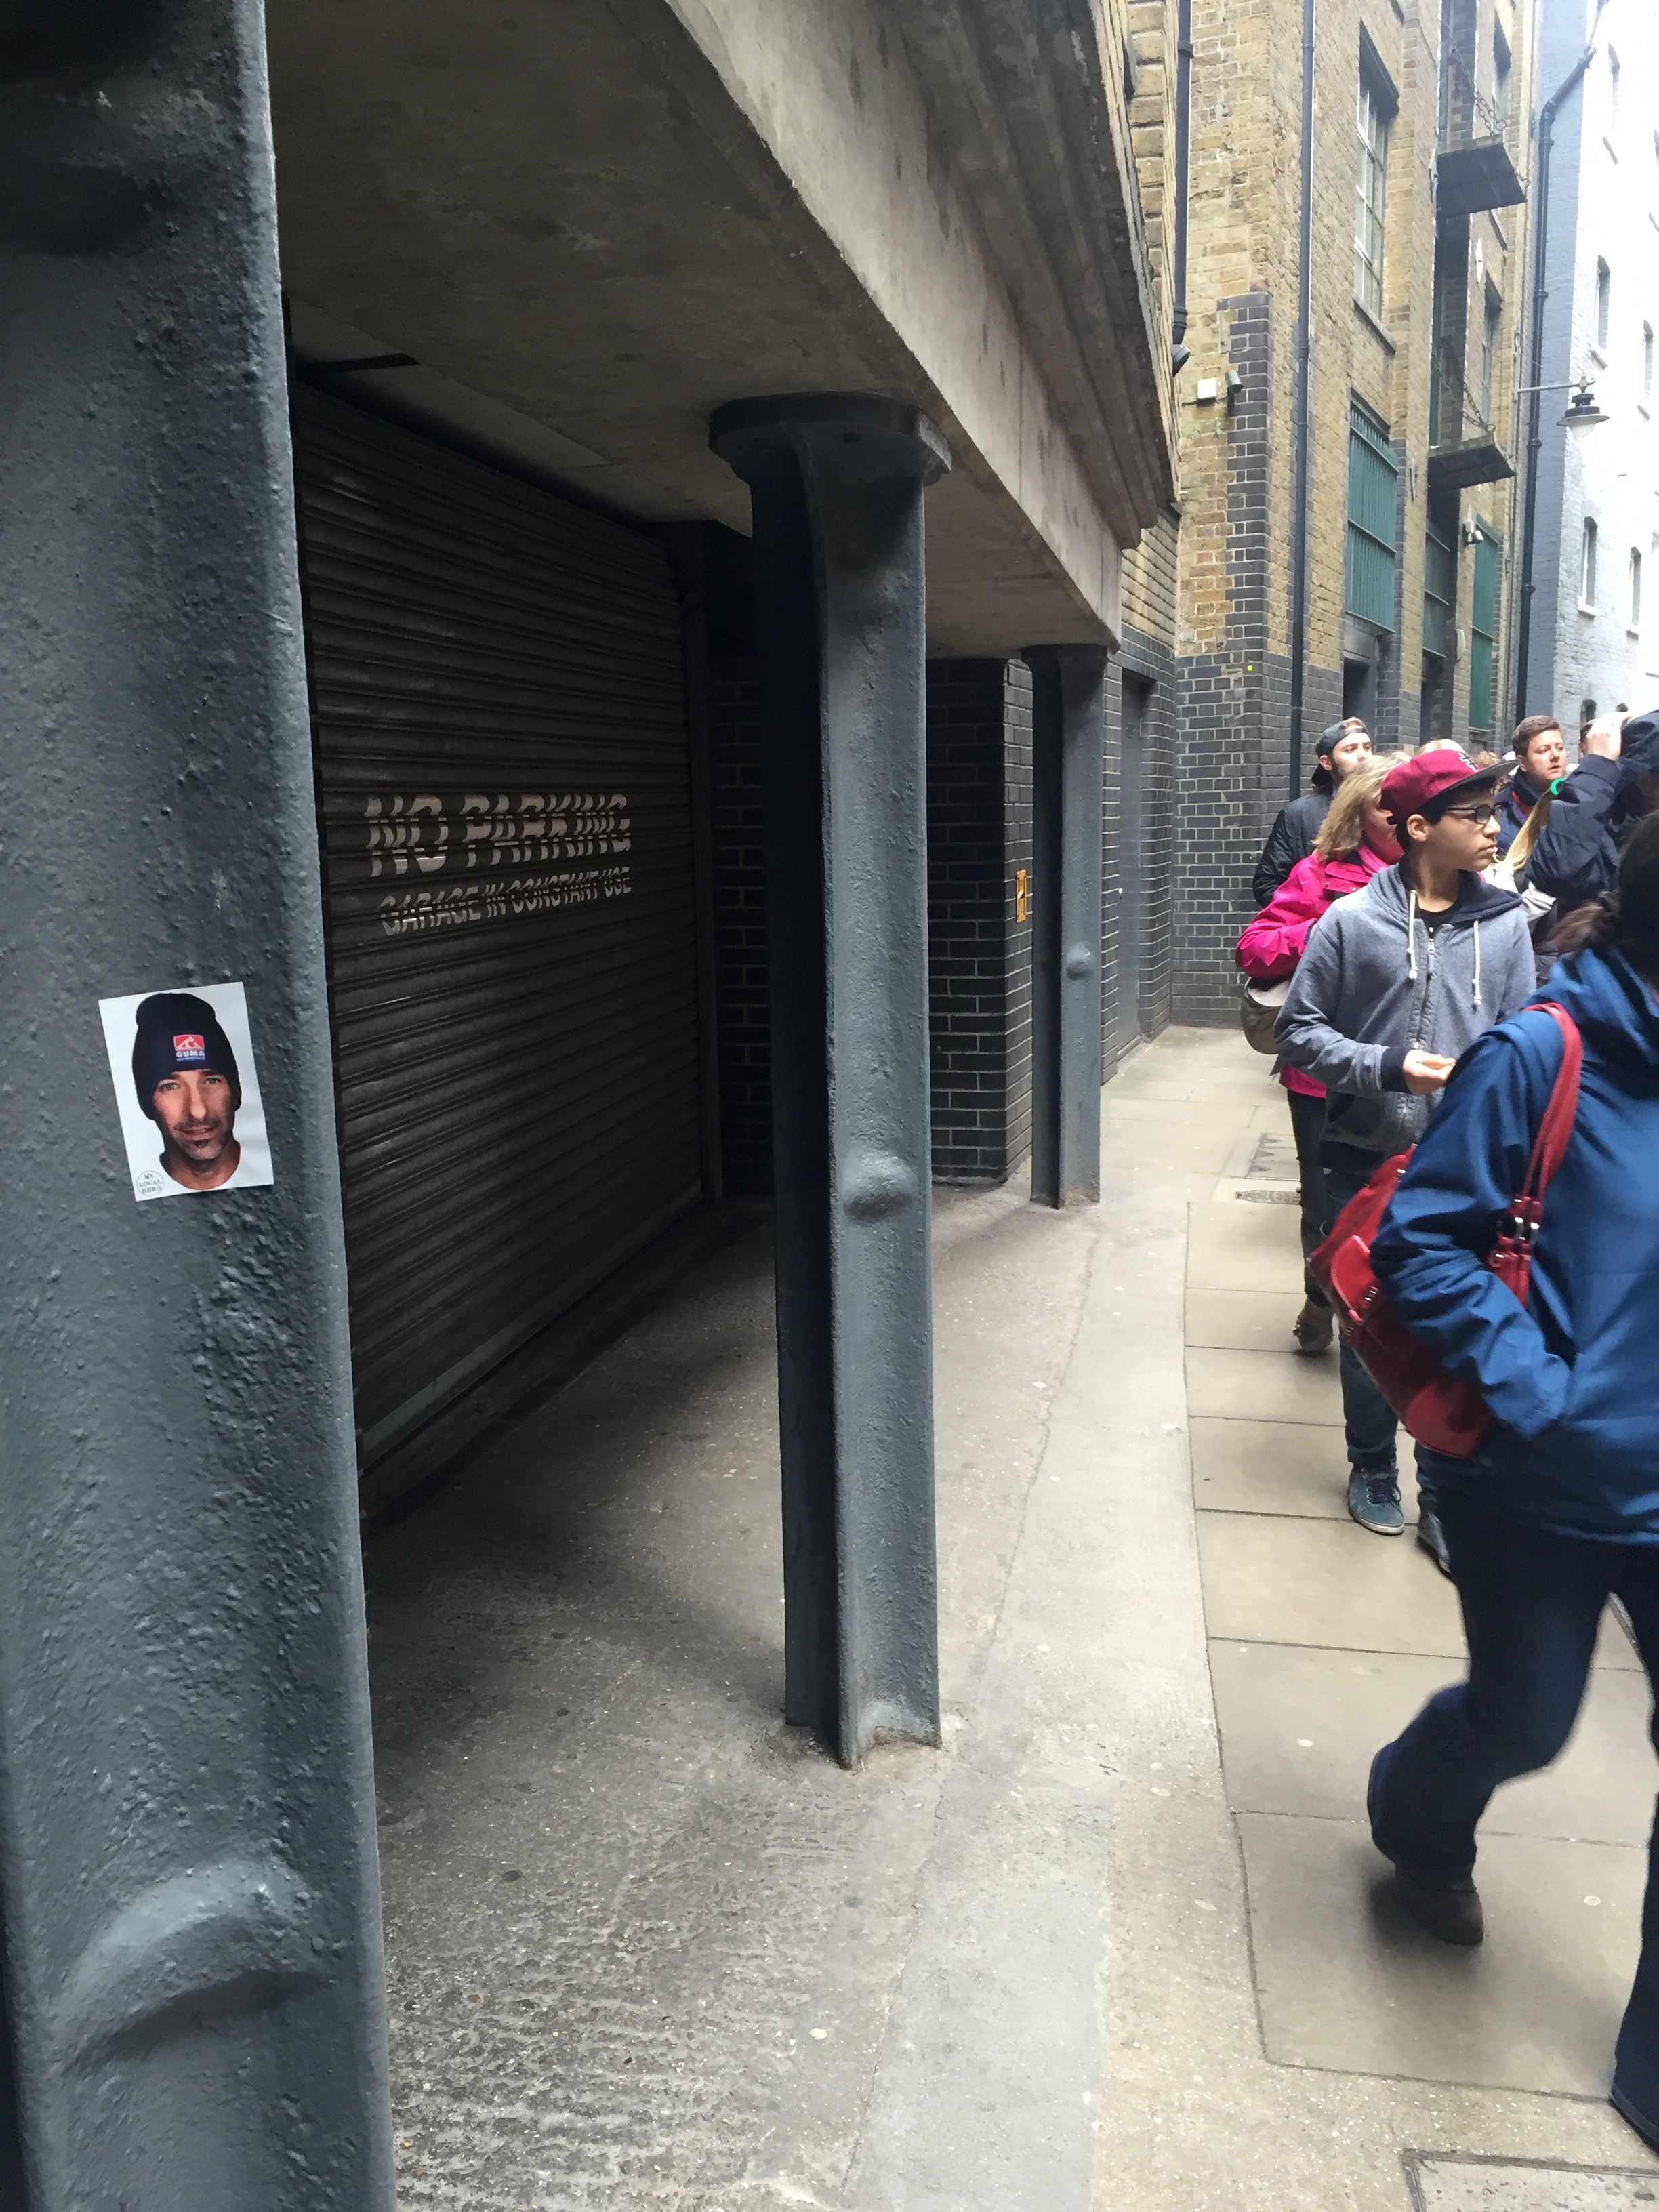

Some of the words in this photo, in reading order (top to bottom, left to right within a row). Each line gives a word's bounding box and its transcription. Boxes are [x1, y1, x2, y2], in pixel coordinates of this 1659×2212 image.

[364, 794, 449, 878] NO
[460, 794, 632, 868] PARKING
[379, 886, 481, 936] GARAGE
[482, 882, 507, 917] IN
[508, 872, 598, 914] CONSTANT
[600, 866, 632, 897] USE
[139, 1179, 163, 1187] LOCAL
